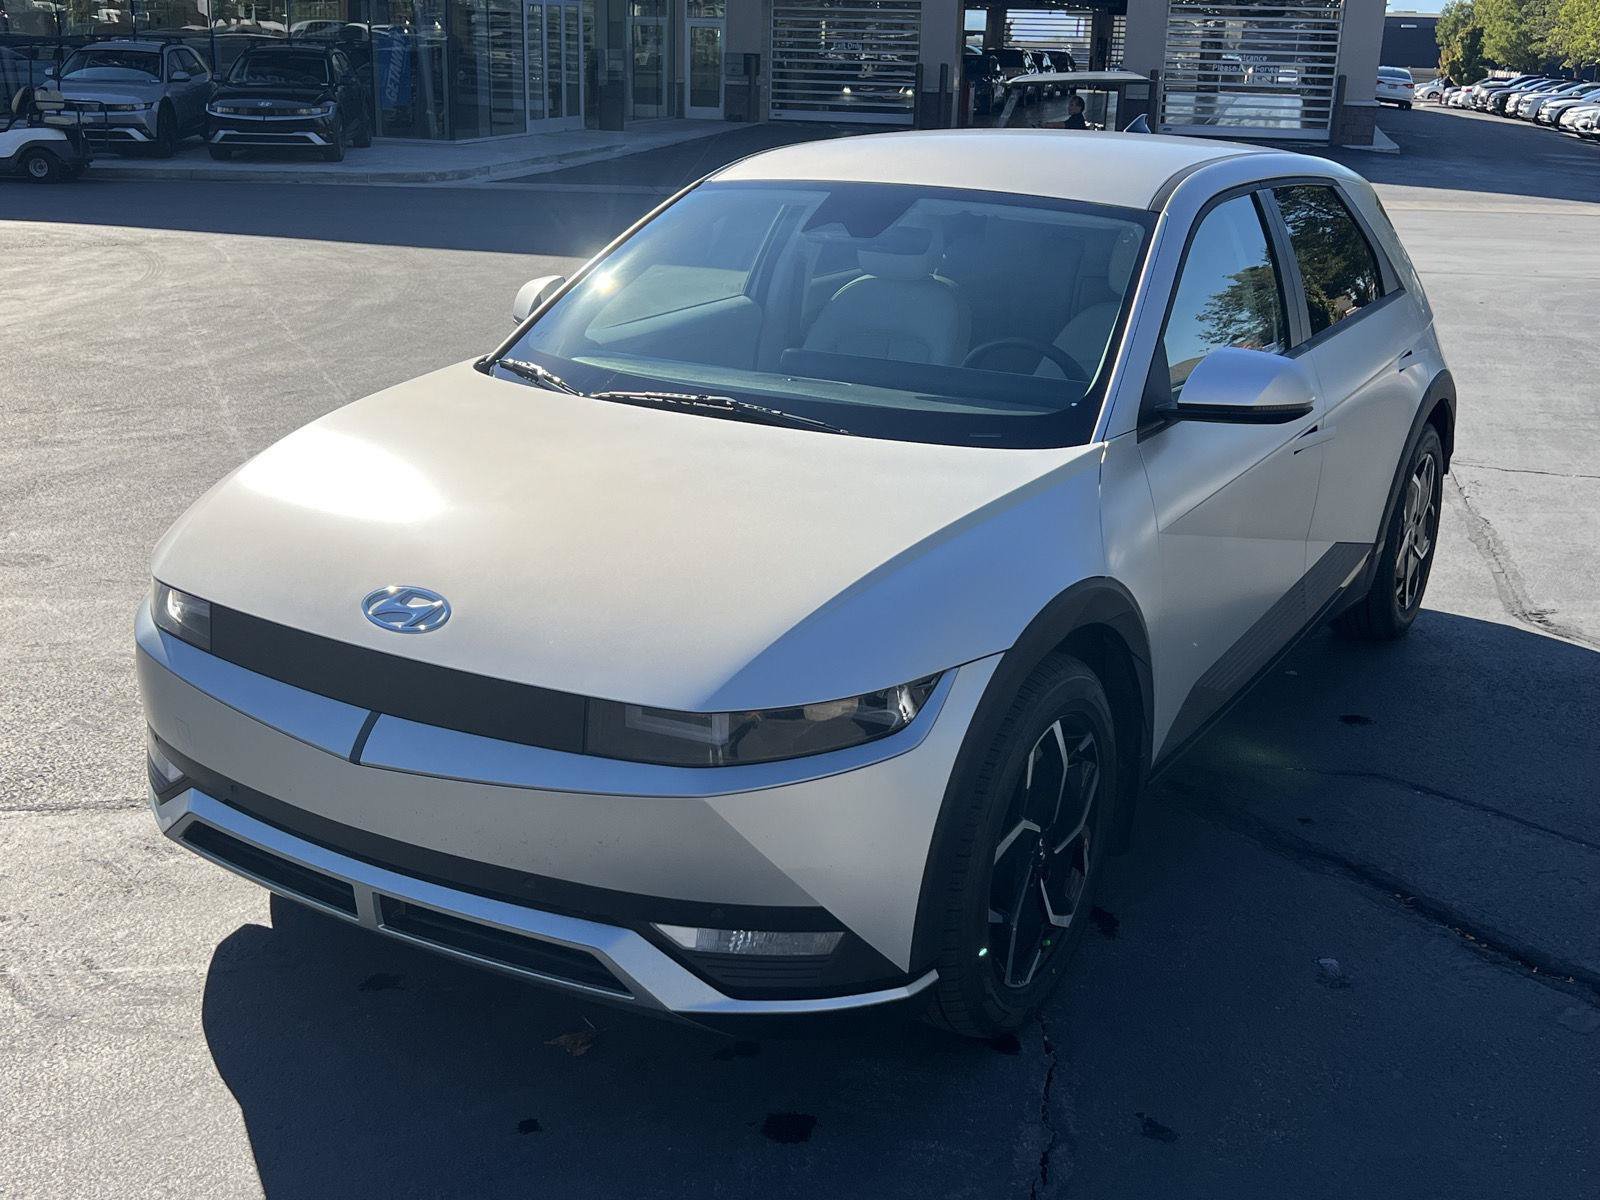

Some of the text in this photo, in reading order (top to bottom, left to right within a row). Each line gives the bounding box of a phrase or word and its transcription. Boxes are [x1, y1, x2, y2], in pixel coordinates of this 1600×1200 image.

[847, 42, 862, 52] Only
[1212, 63, 1237, 72] Please
[1255, 65, 1280, 73] Forwa
